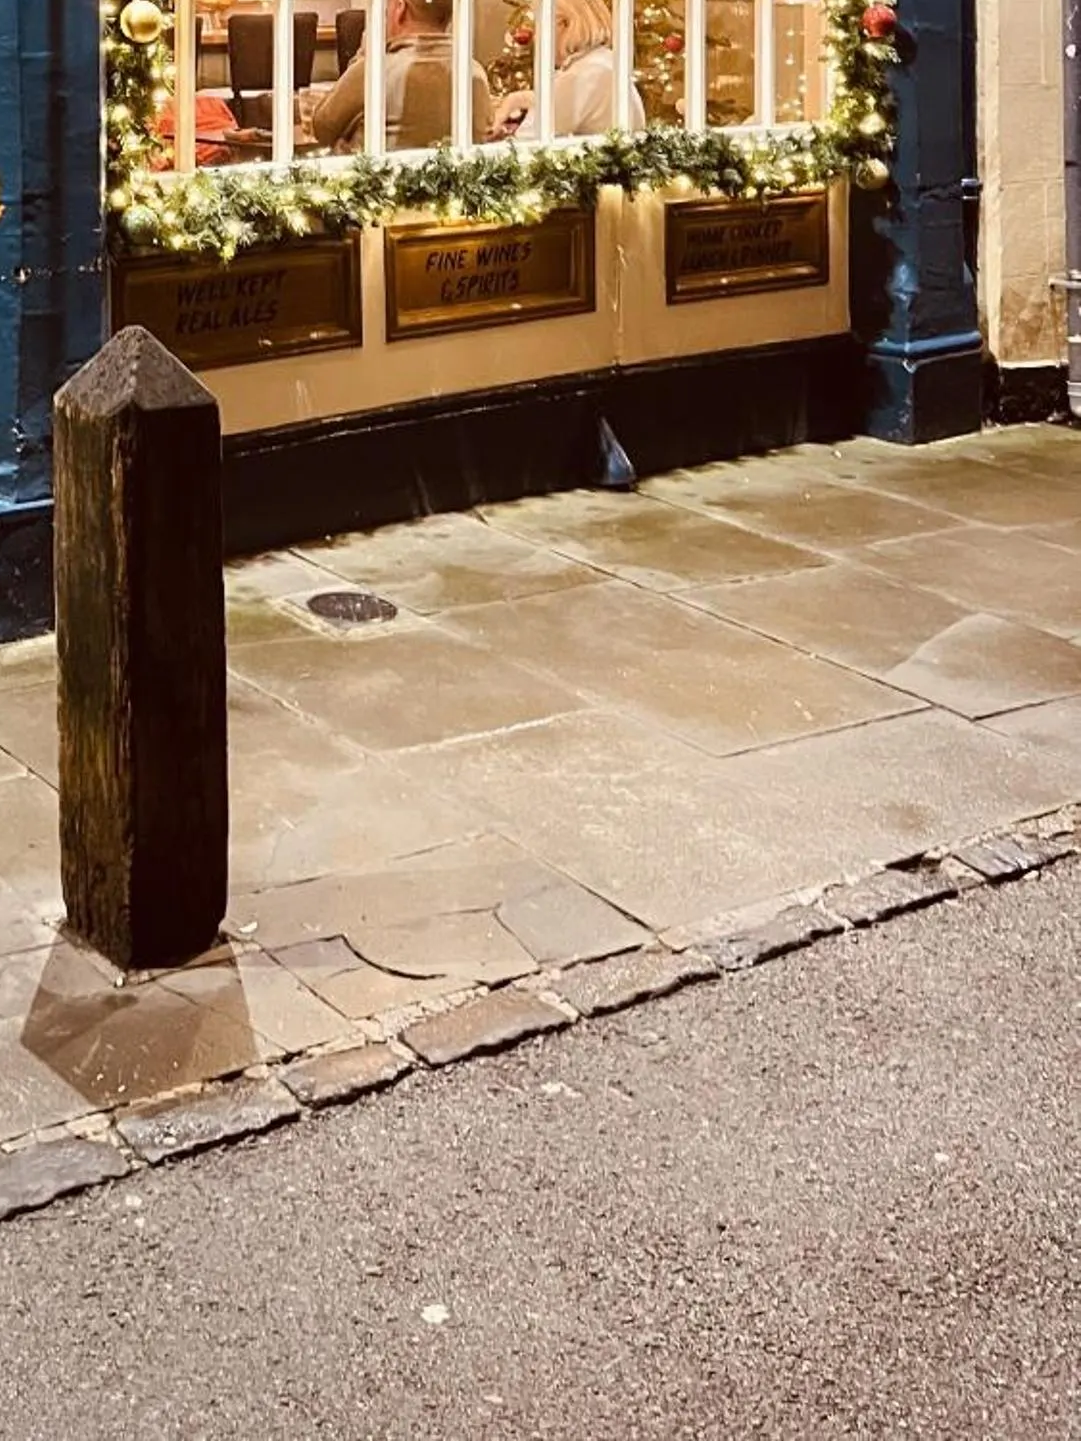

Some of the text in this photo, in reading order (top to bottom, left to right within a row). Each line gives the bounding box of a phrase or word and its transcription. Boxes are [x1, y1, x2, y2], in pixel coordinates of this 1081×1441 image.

[425, 242, 532, 273] FINE WINES
[176, 269, 288, 307] WELL KEPT
[175, 298, 280, 335] REAL ALES
